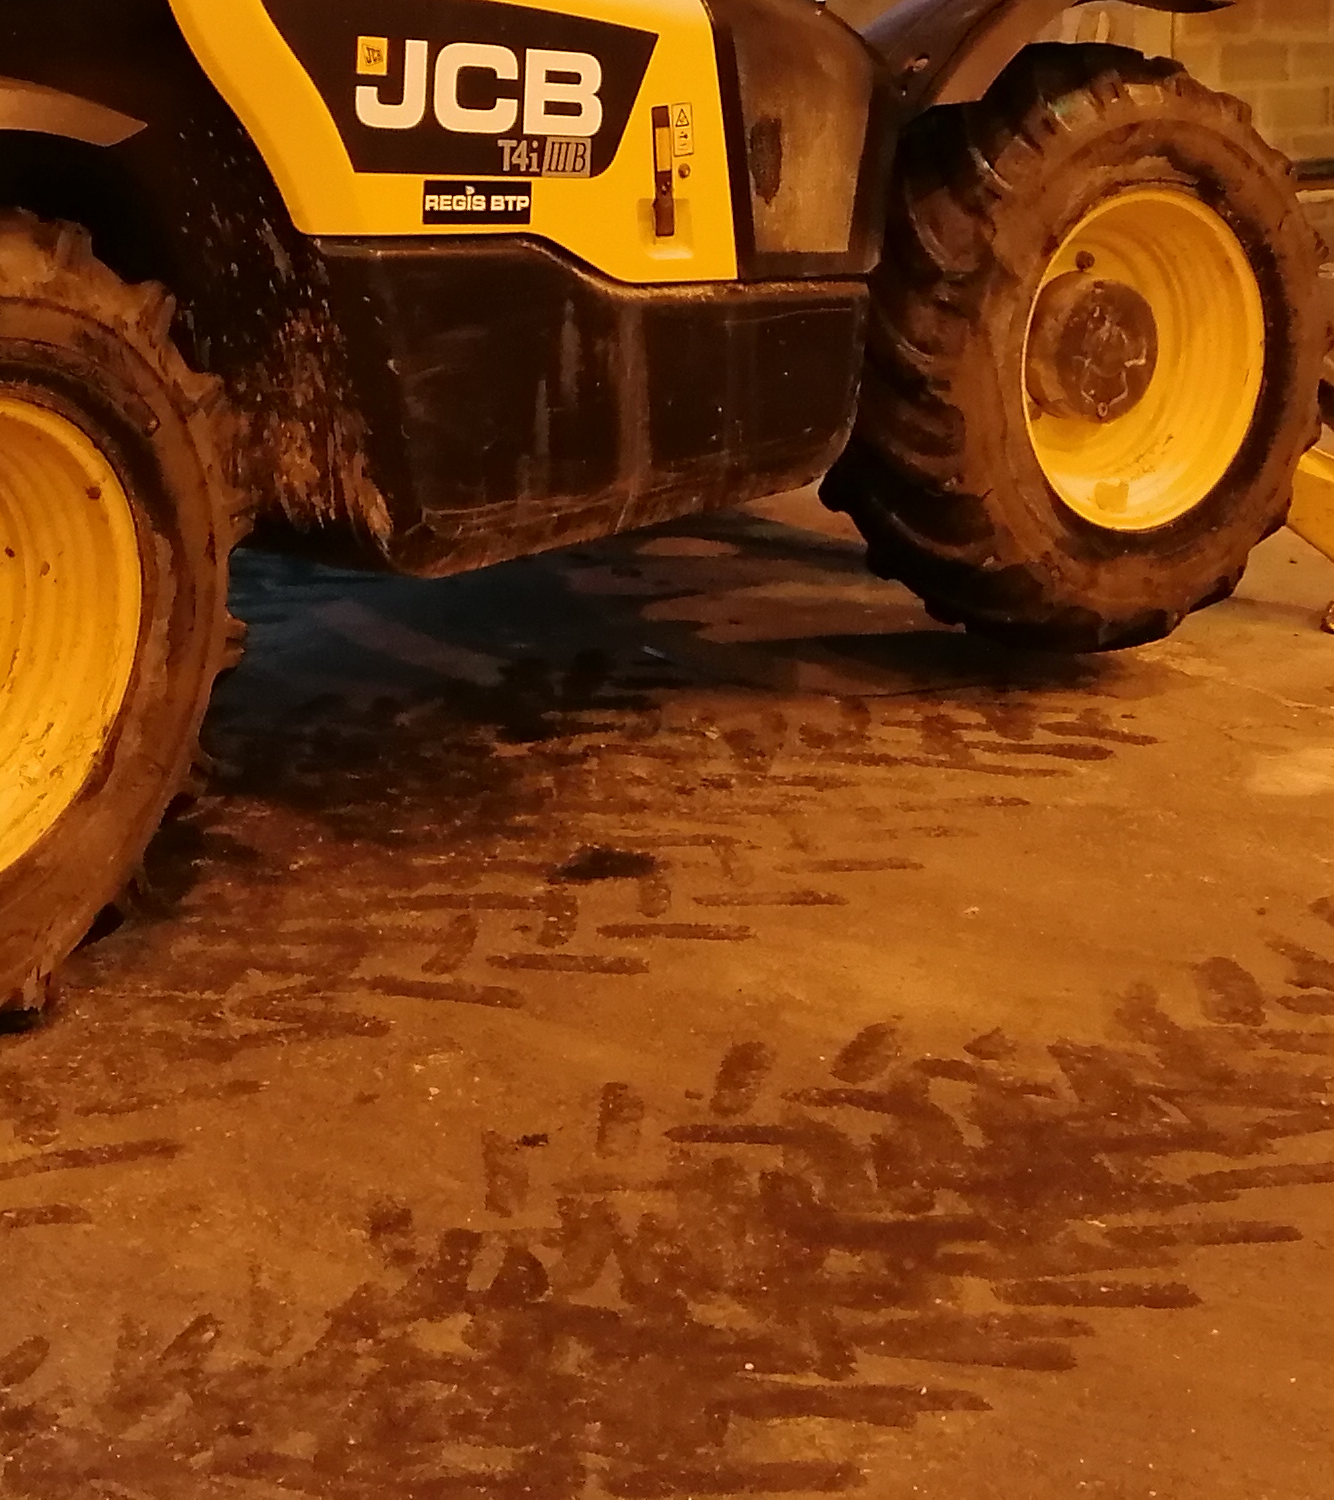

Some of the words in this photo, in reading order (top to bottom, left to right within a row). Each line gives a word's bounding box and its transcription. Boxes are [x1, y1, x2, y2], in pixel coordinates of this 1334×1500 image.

[355, 39, 603, 138] JCB
[497, 139, 541, 172] T4i
[490, 195, 530, 212] BTP
